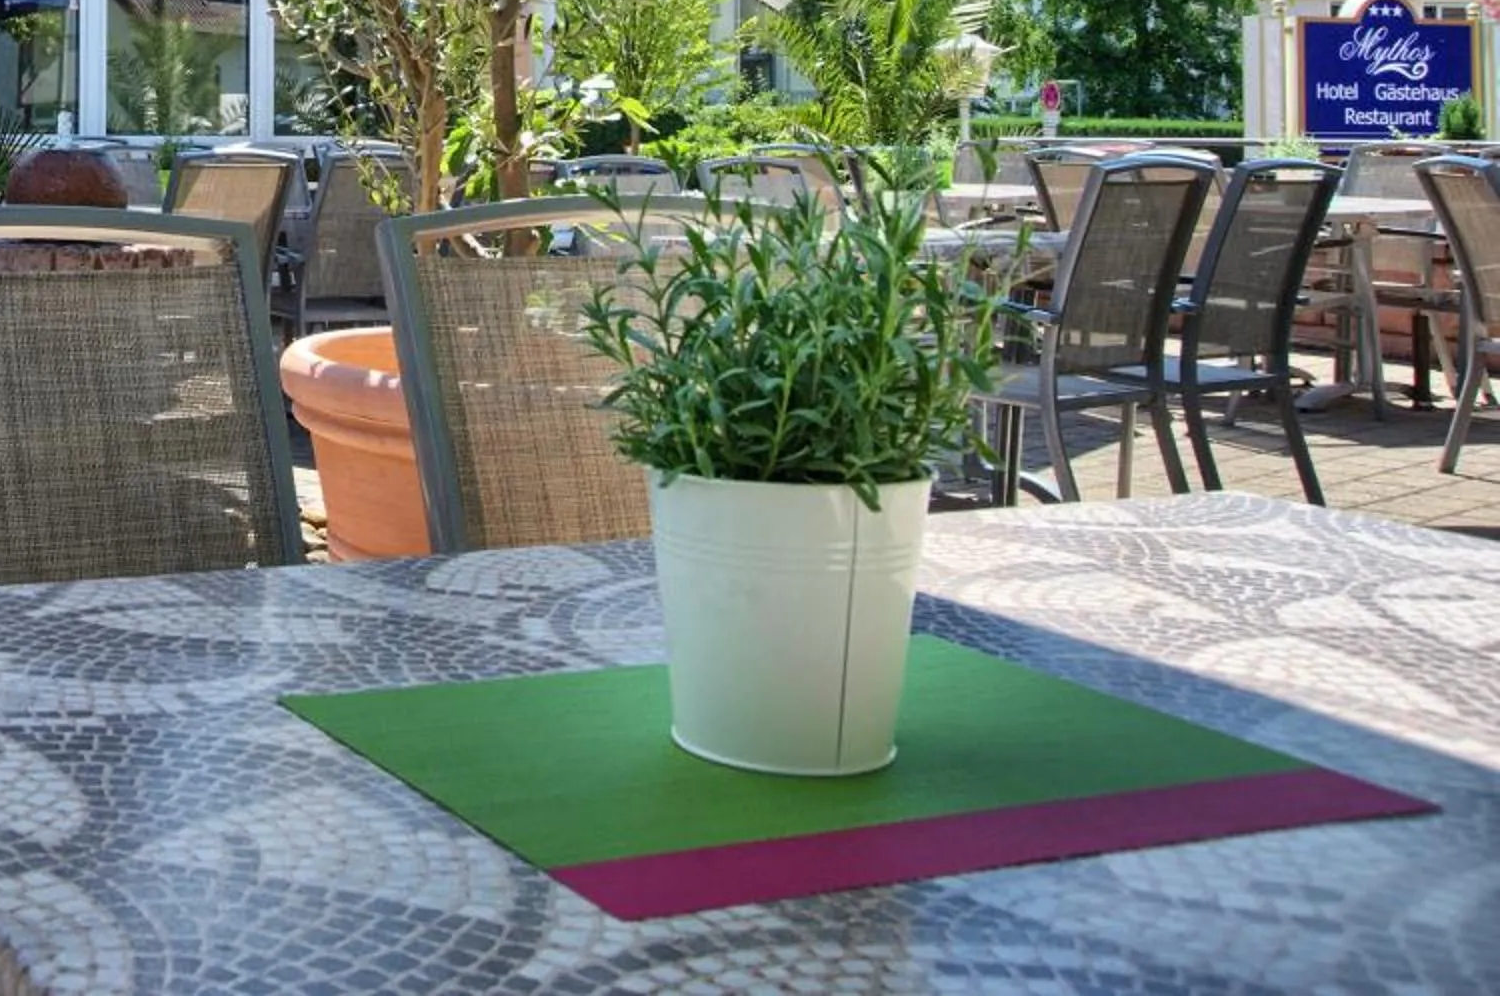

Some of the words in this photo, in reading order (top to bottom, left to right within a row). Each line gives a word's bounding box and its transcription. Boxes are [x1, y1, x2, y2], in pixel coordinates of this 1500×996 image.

[1339, 25, 1434, 79] Mythos
[1316, 82, 1359, 100] Hotel
[1375, 82, 1460, 101] Gästehaus
[1345, 108, 1433, 126] Restaurant
